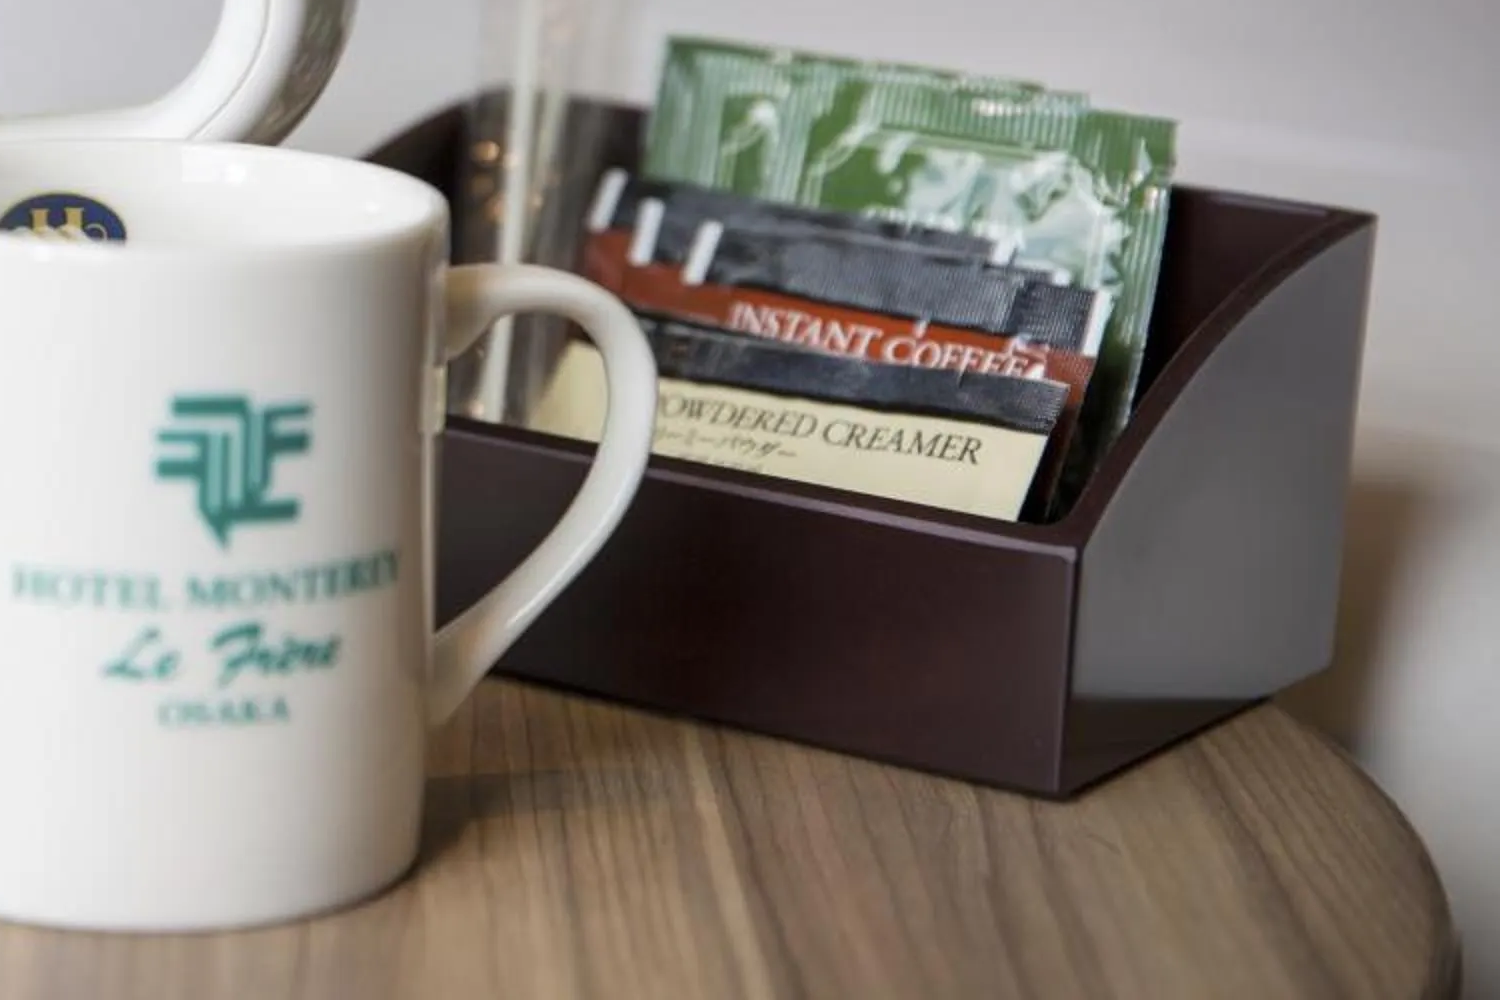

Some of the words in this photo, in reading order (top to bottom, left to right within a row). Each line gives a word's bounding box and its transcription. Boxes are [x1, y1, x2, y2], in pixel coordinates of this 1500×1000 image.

[729, 301, 883, 356] INSTANT
[882, 335, 1029, 377] COFFEE
[657, 393, 819, 440] OWDERED
[822, 418, 984, 465] CREAMER
[10, 562, 166, 611] HOTEL
[102, 626, 182, 680] Le
[157, 697, 290, 727] OSAKA
